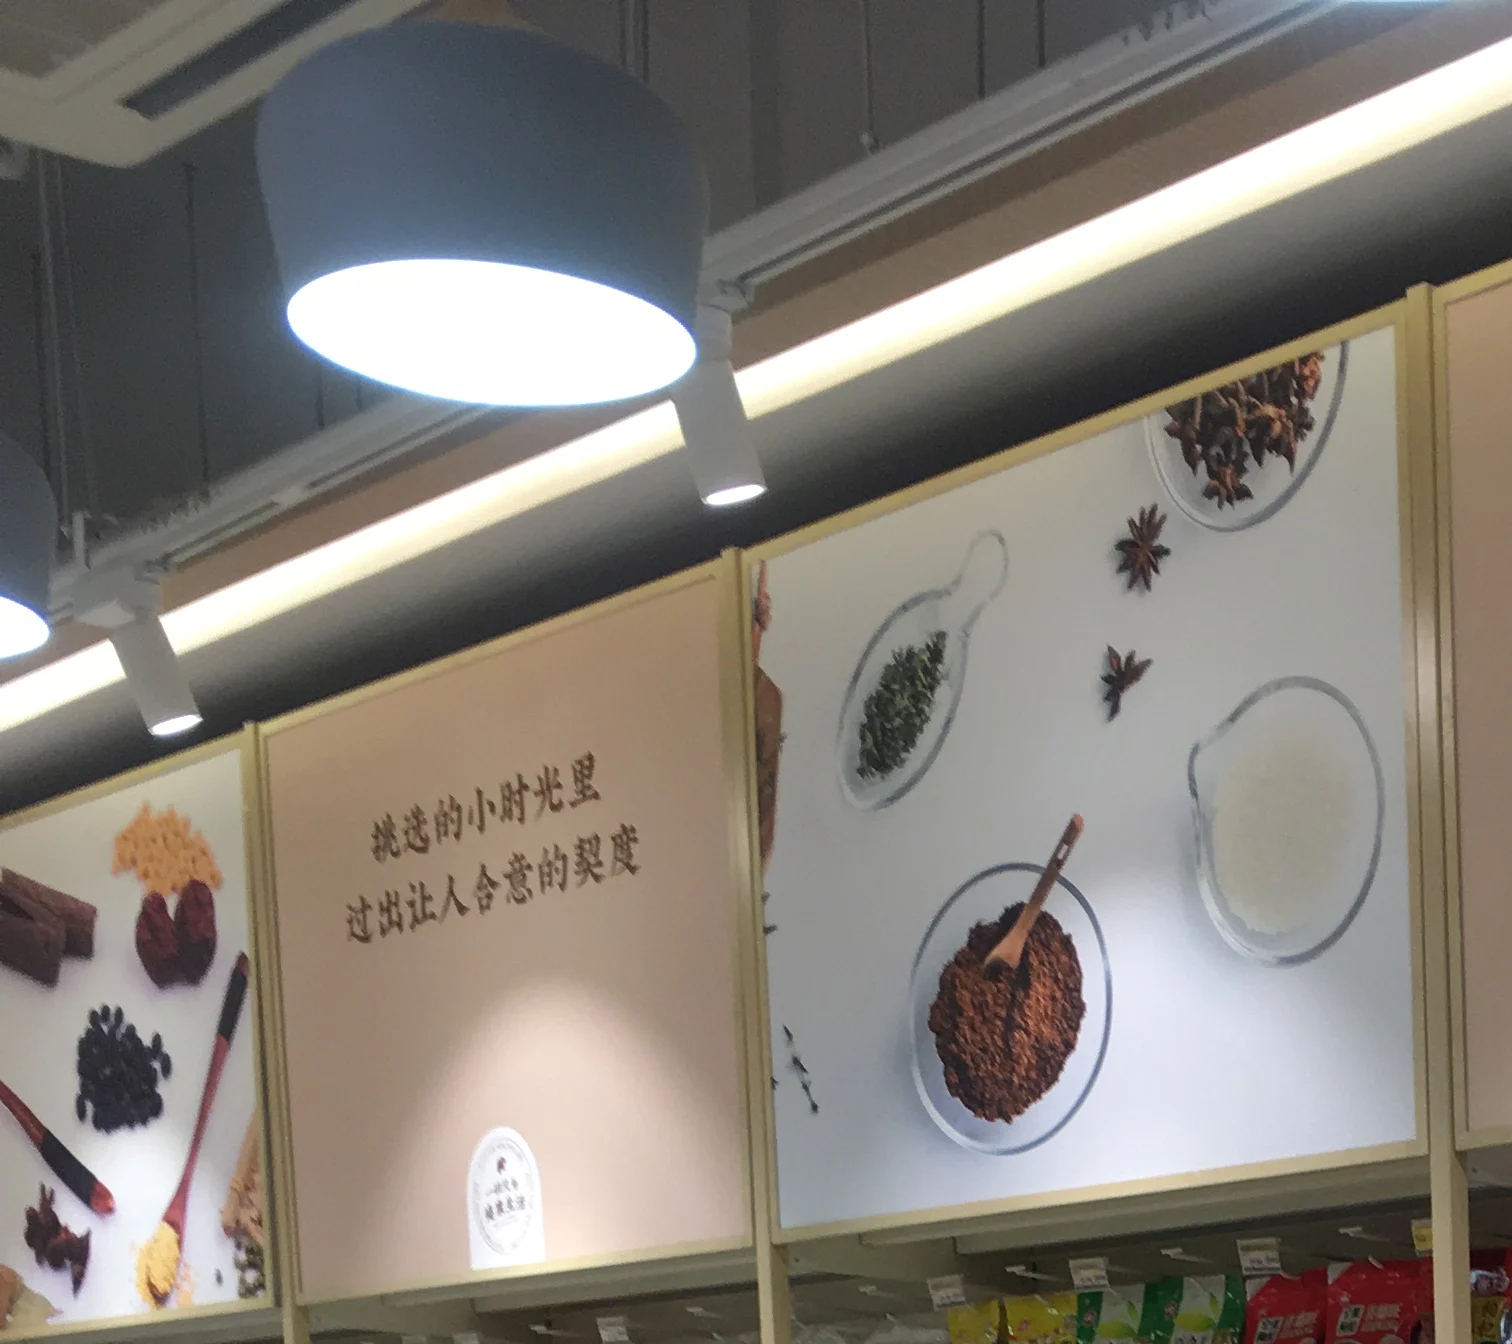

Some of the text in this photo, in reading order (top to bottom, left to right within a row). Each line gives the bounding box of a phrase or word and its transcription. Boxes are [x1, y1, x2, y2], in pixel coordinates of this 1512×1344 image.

[369, 750, 602, 865] 挑选的小时光里
[345, 822, 642, 944] 过出让人合意的契度
